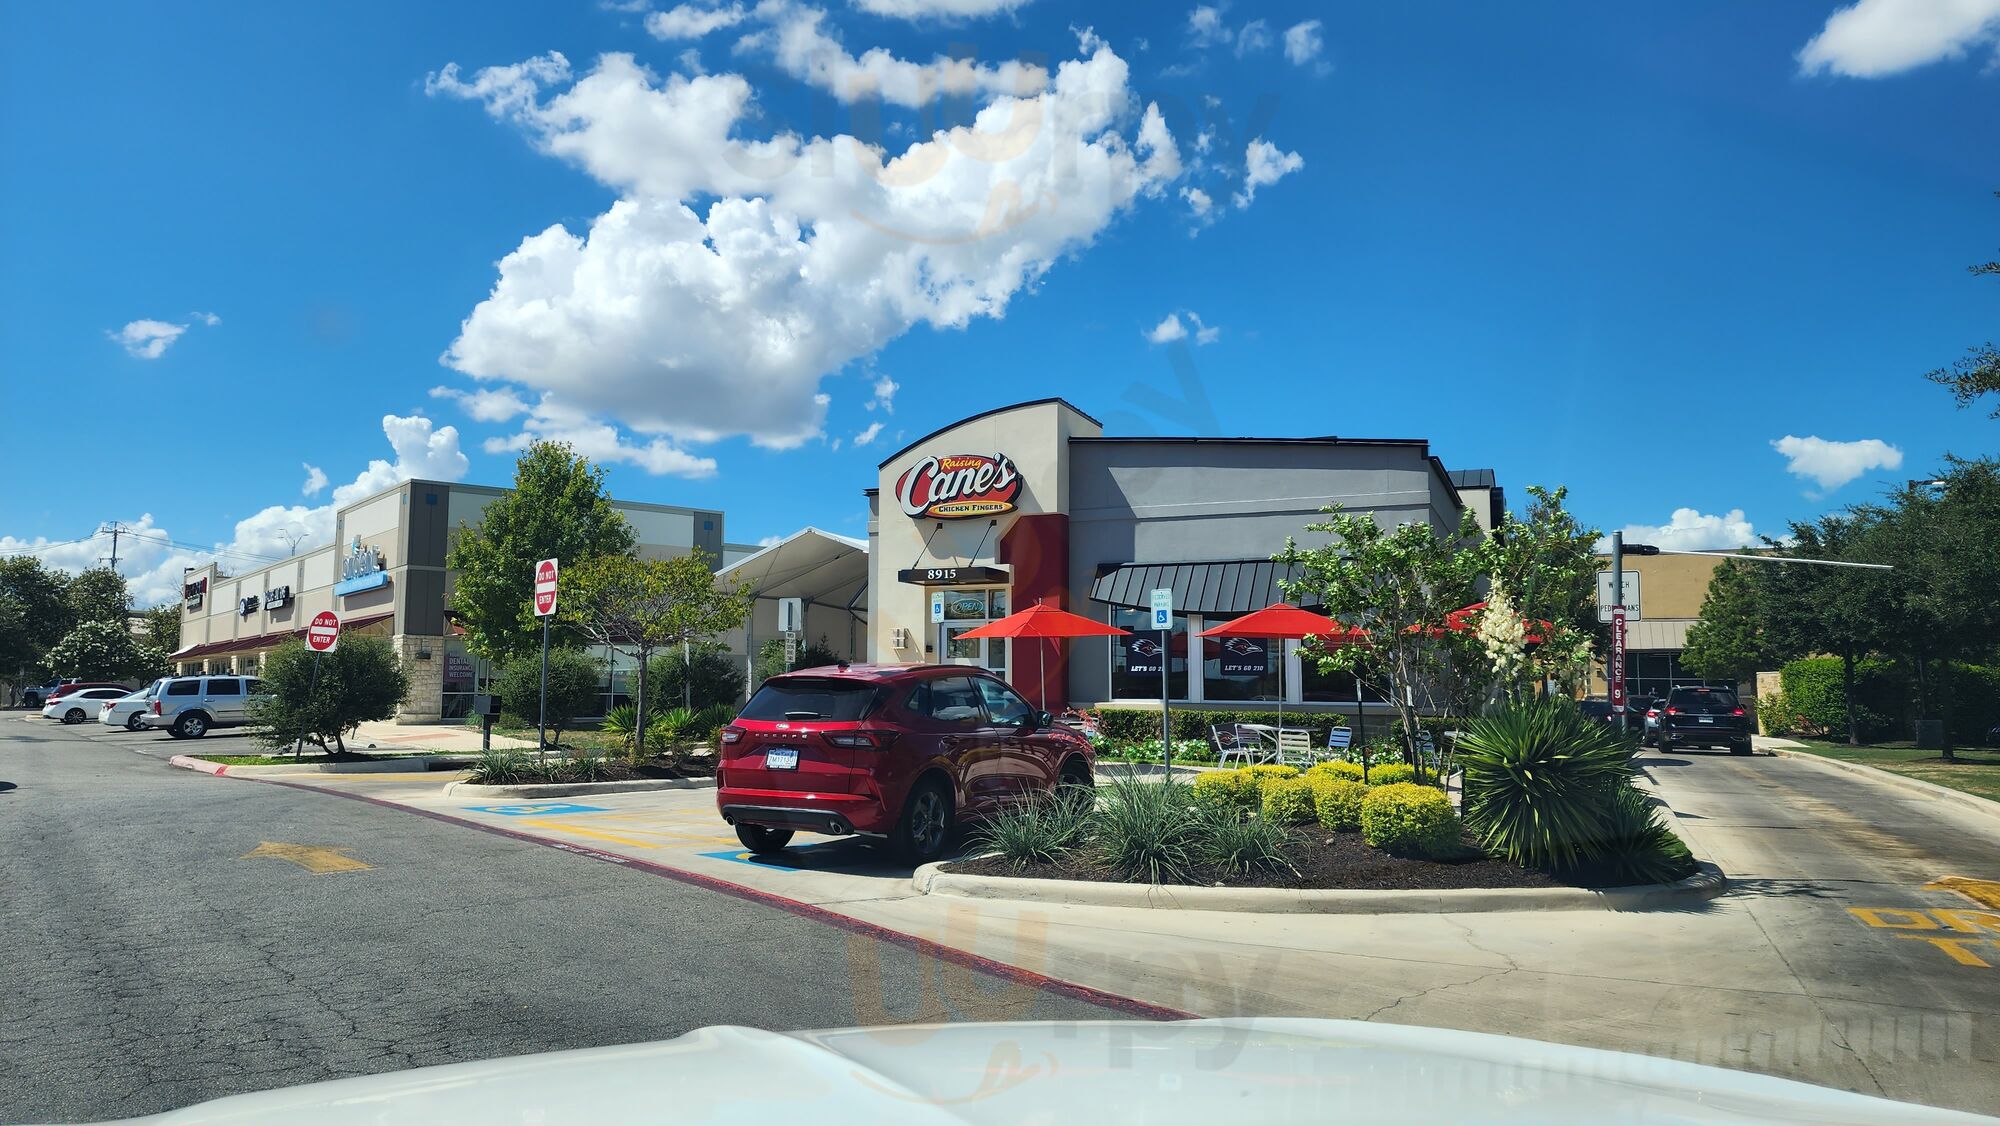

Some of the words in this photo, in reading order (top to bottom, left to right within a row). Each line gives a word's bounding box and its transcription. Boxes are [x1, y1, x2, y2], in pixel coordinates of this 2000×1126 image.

[941, 458, 981, 470] Raising
[900, 452, 1016, 516] Cane's
[539, 571, 545, 581] DO
[545, 570, 554, 580] NOT
[927, 569, 957, 579] 8915
[539, 594, 551, 605] ENTER
[955, 602, 980, 611] OPEN
[1600, 604, 1640, 612] PEDANS
[324, 618, 336, 626] NOT
[312, 635, 331, 644] ENTER
